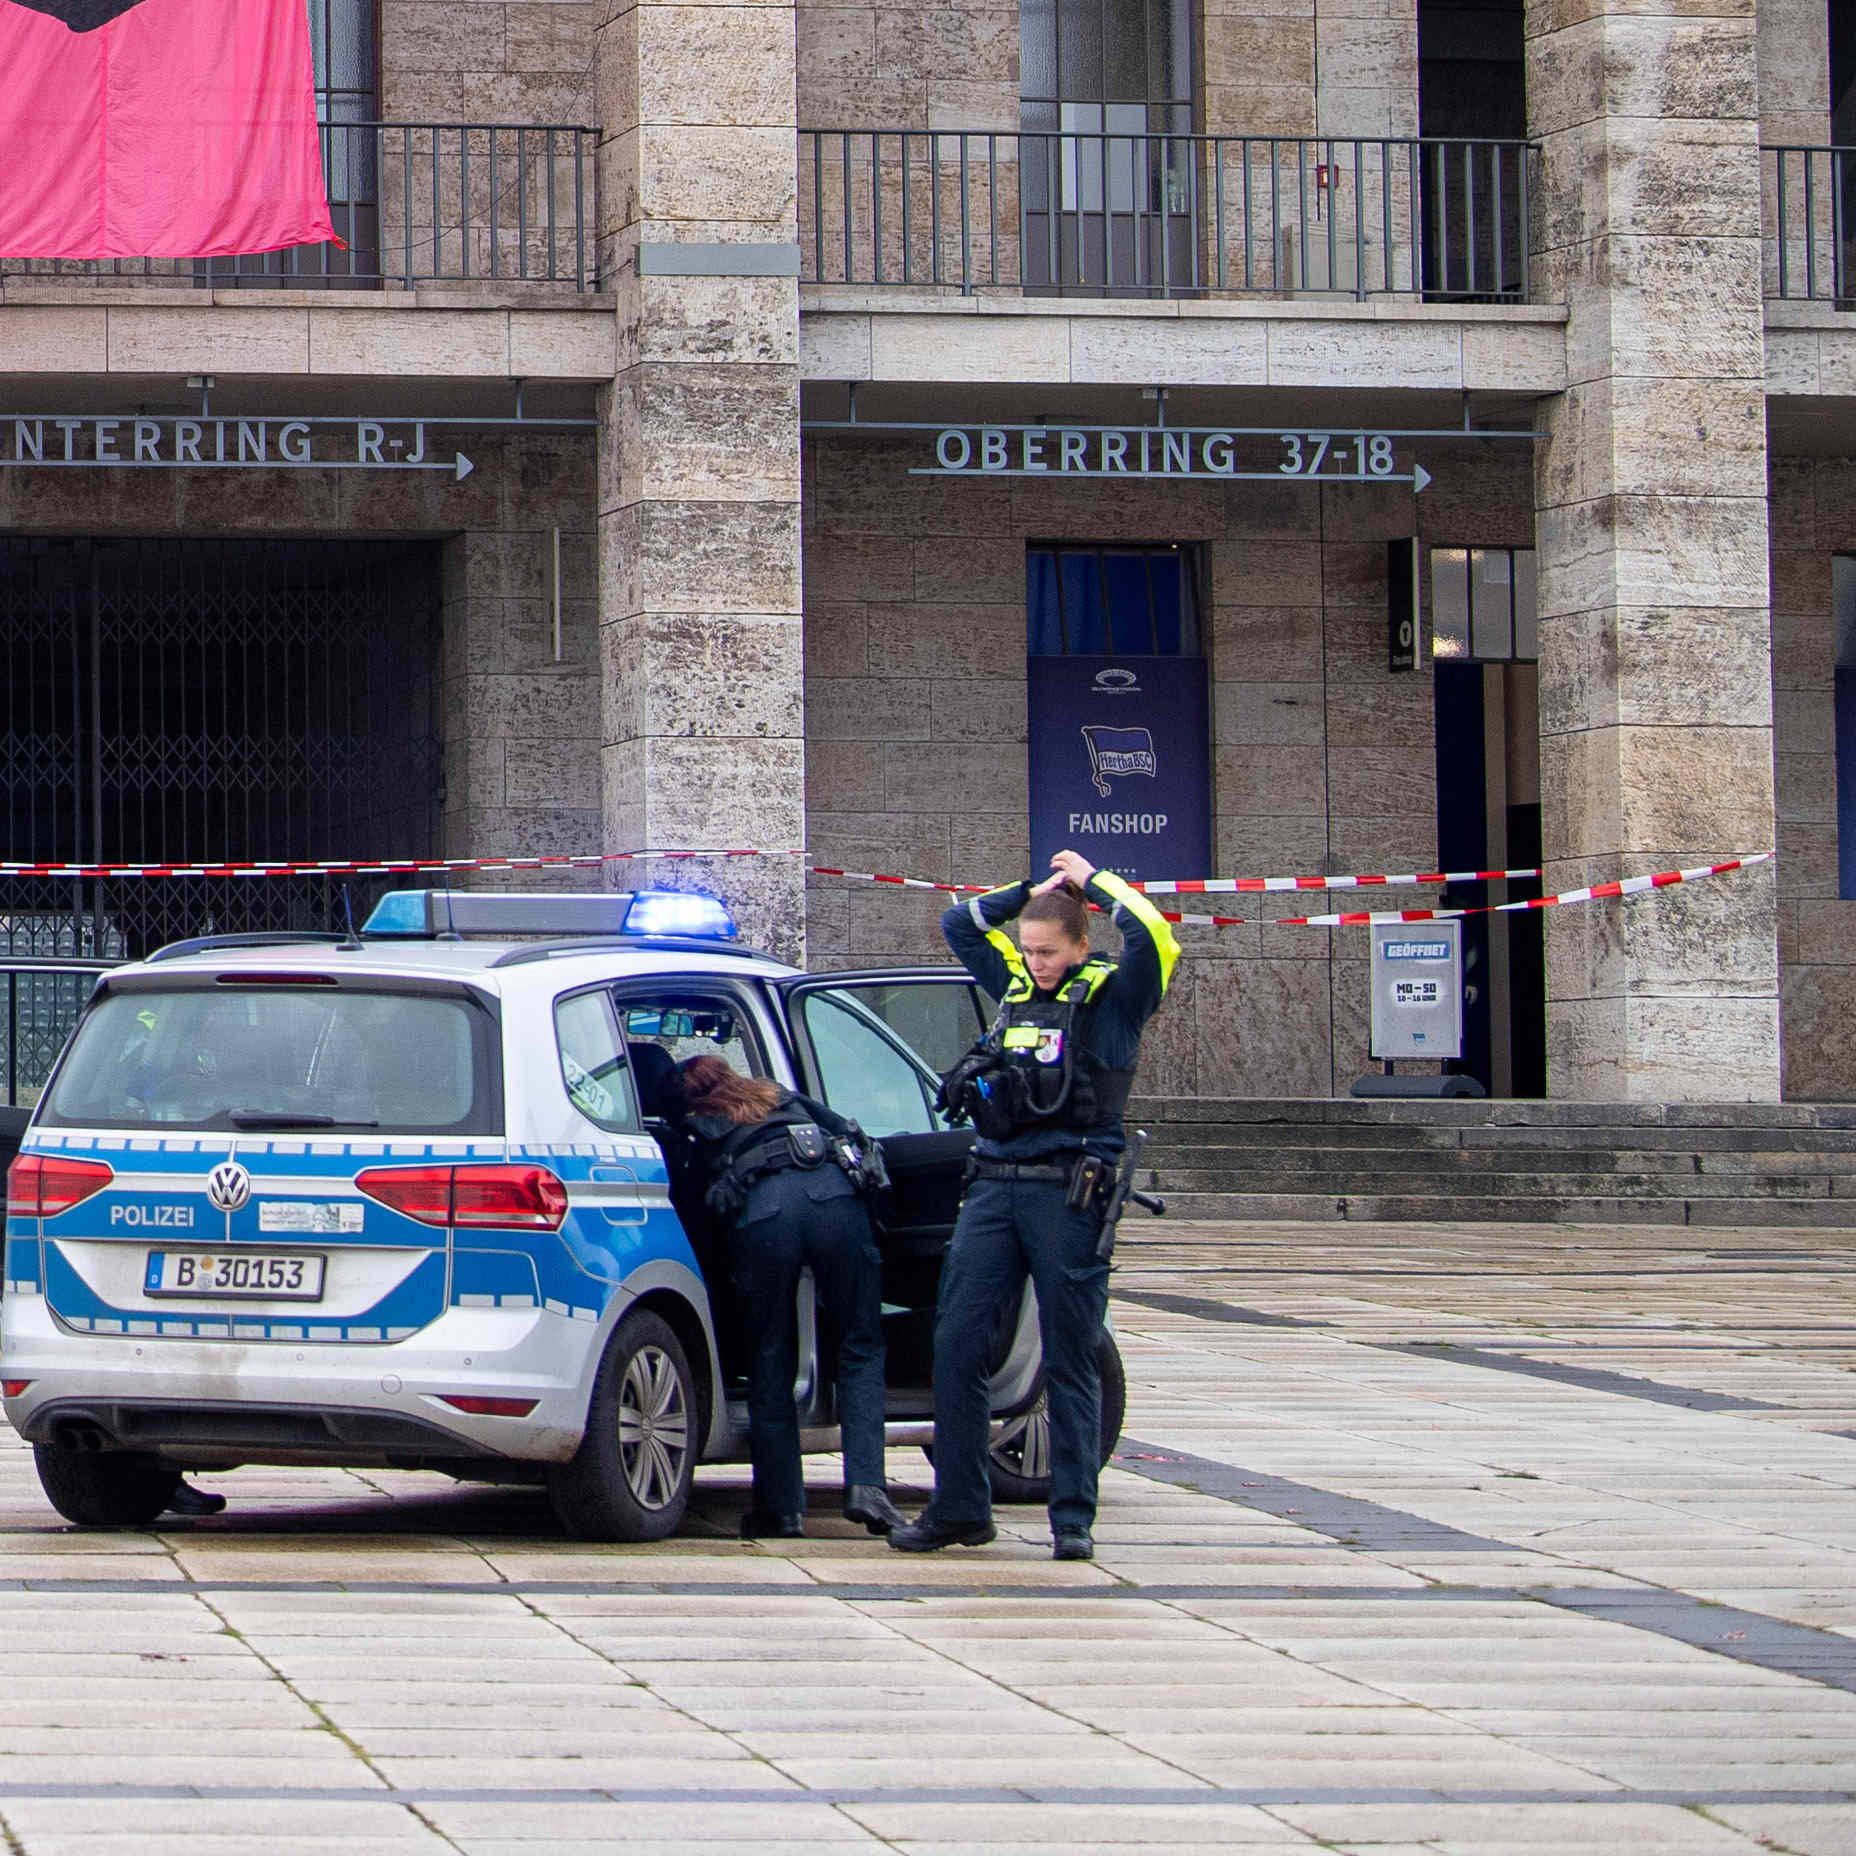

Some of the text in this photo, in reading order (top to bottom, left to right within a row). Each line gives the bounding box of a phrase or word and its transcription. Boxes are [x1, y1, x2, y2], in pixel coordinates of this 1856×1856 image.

[358, 422, 425, 464] R-J
[936, 429, 1393, 476] OBERRING 37-18
[1069, 813, 1168, 834] FANSHOP
[110, 1205, 195, 1227] POLIZEI
[177, 1257, 195, 1287] B
[215, 1258, 305, 1289] 30153
